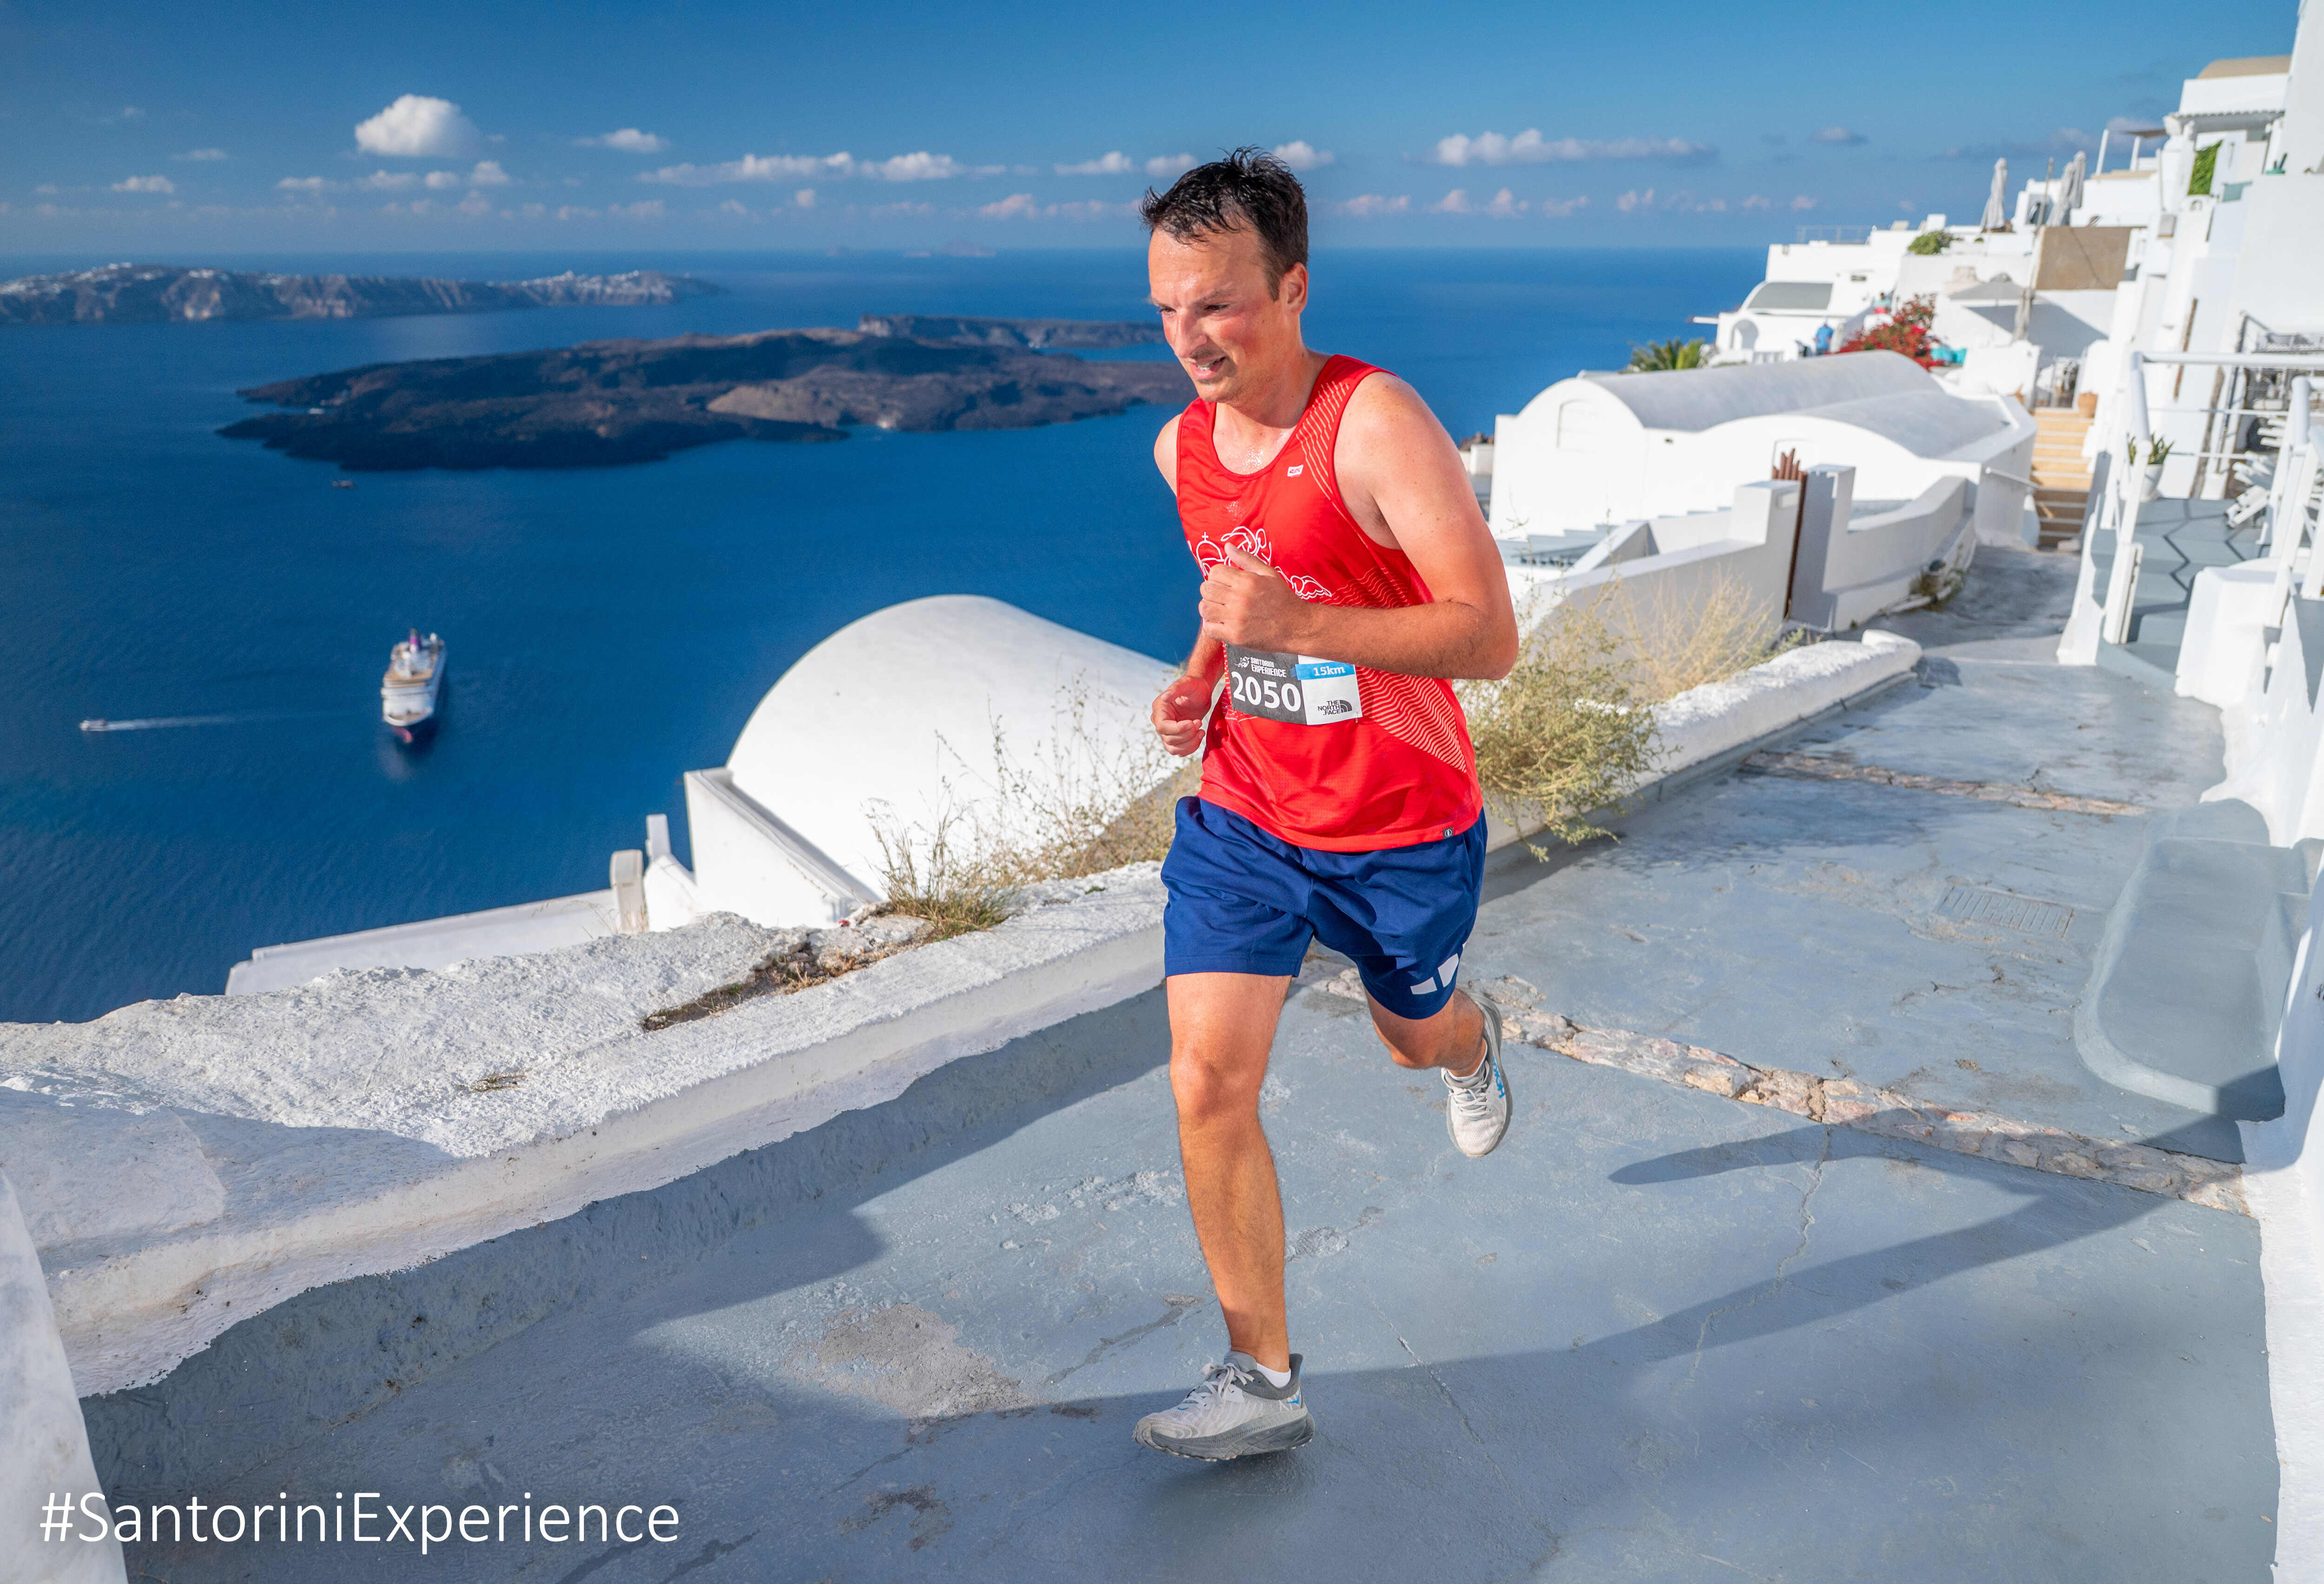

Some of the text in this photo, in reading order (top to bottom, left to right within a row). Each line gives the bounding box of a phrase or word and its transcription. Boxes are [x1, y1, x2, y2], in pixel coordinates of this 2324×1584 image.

[1251, 664, 1287, 677] EXPERIENCE
[1313, 666, 1345, 676] 15km
[1231, 671, 1301, 712] 2050
